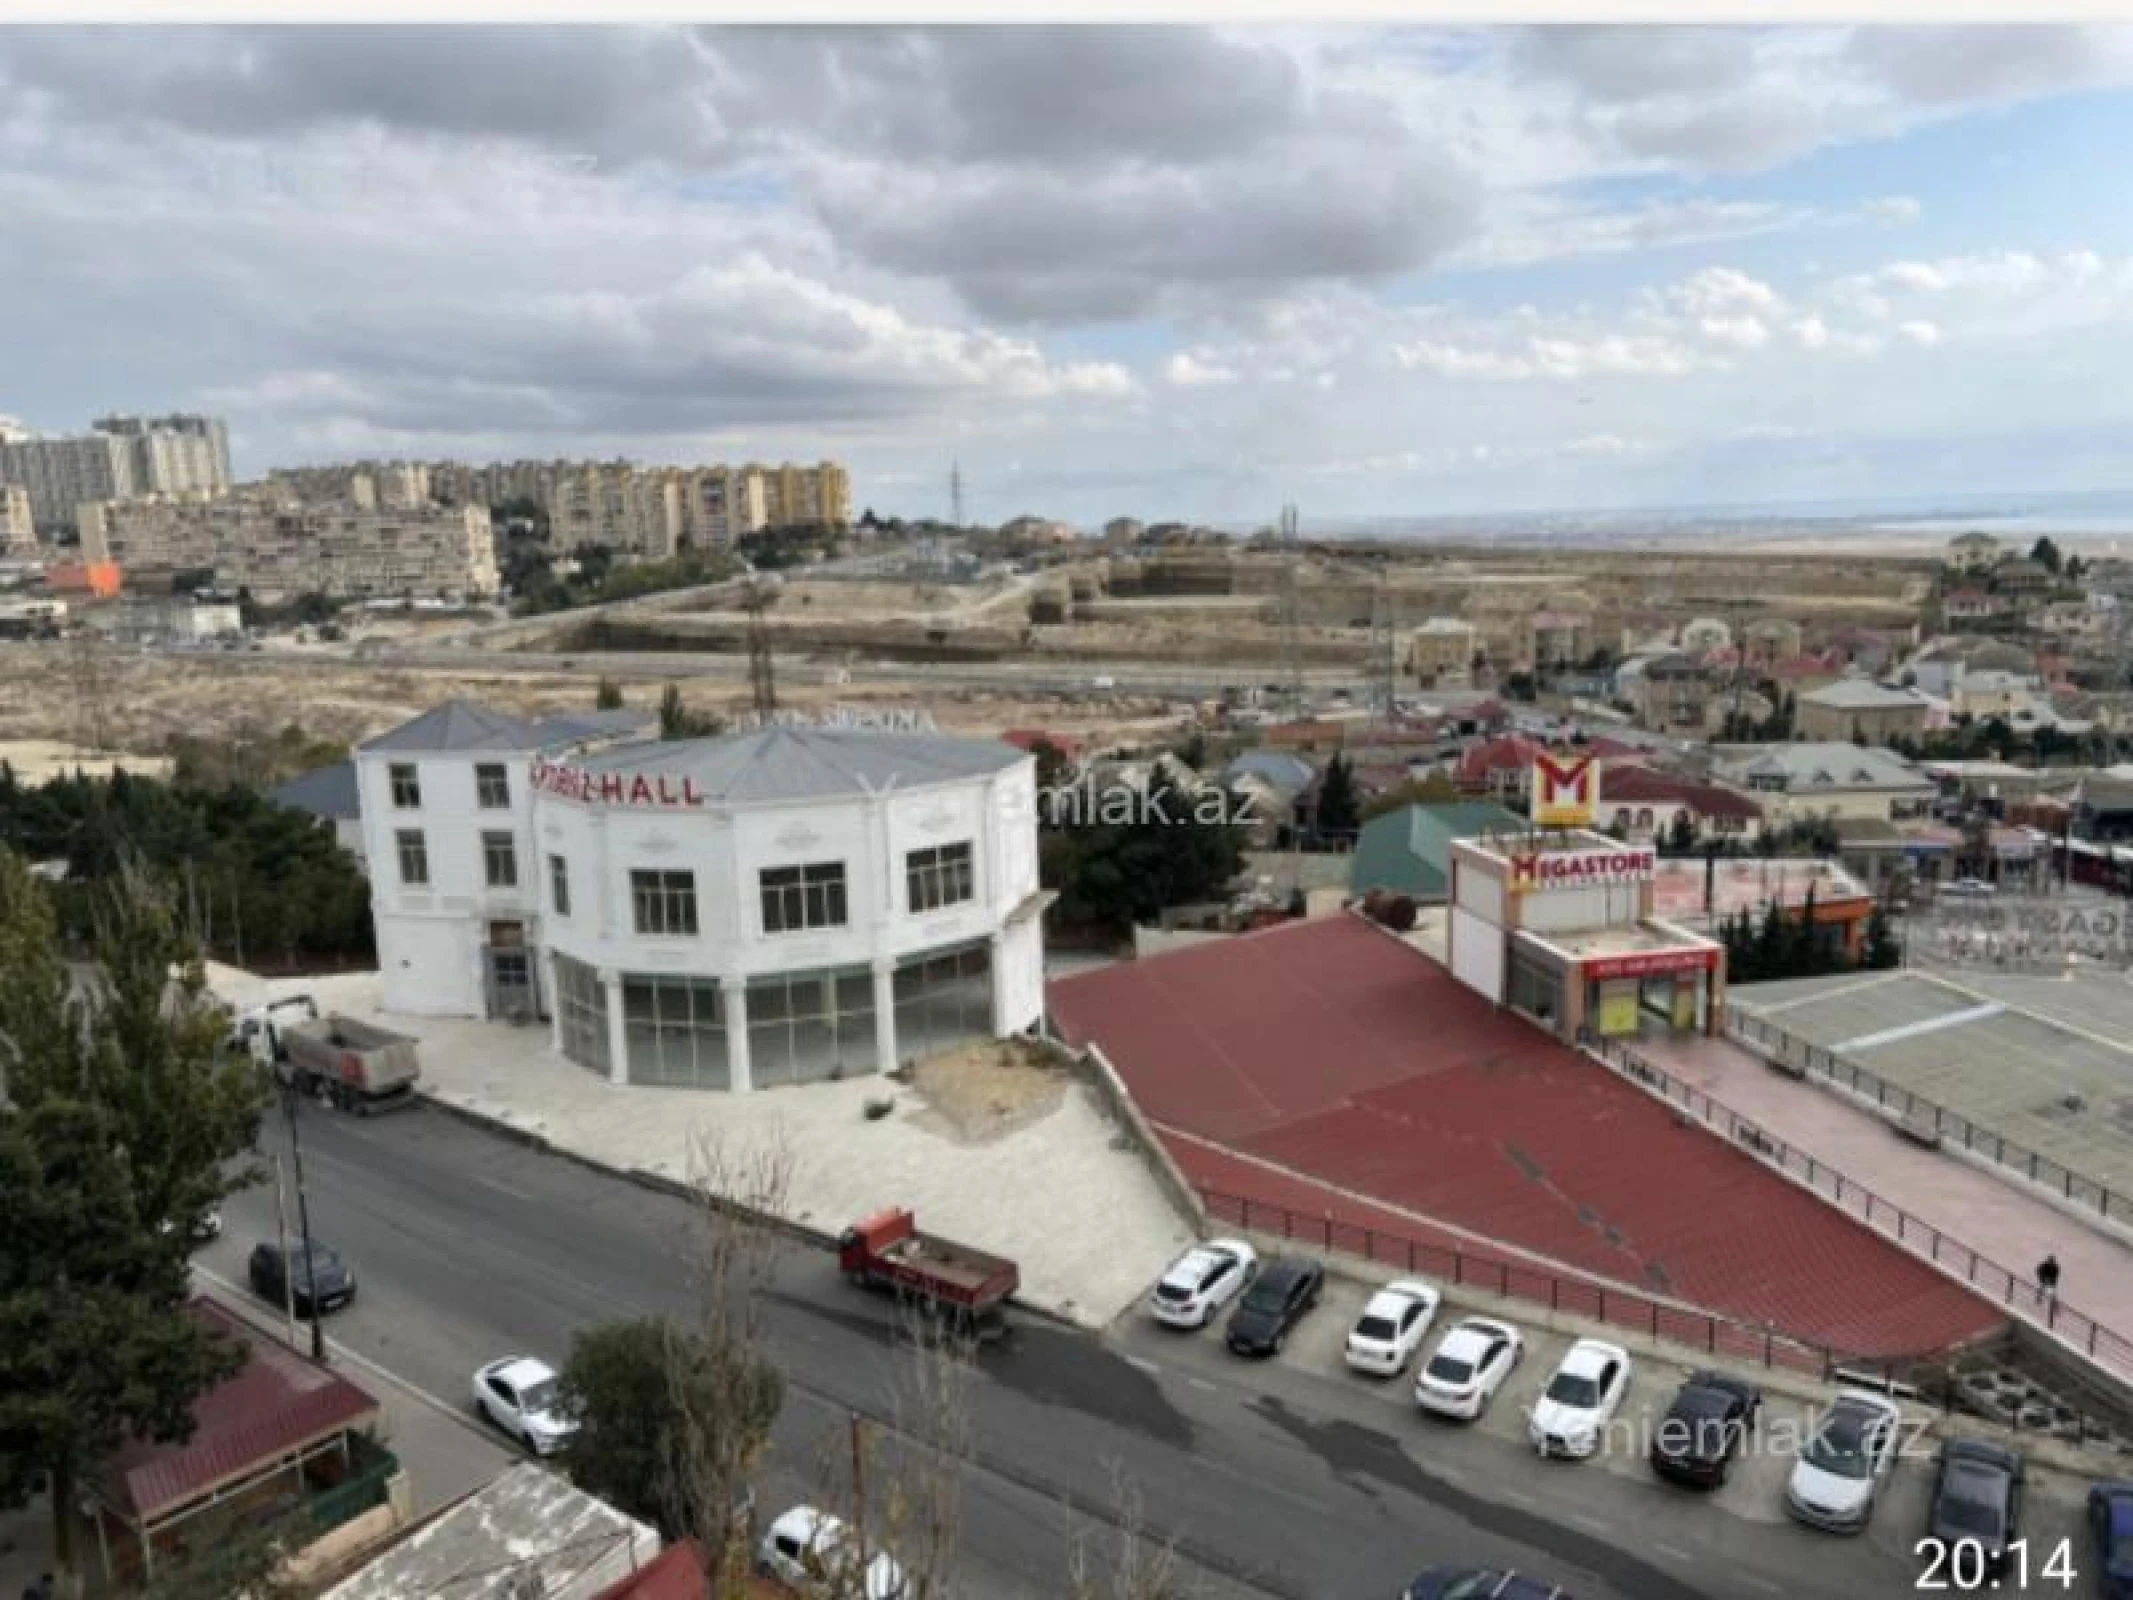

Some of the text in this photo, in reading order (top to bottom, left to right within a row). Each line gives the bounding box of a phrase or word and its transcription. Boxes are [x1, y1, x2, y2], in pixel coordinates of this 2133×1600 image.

[602, 774, 704, 805] HALL
[1535, 754, 1597, 803] M
[1511, 852, 1653, 881] MEGASTORE
